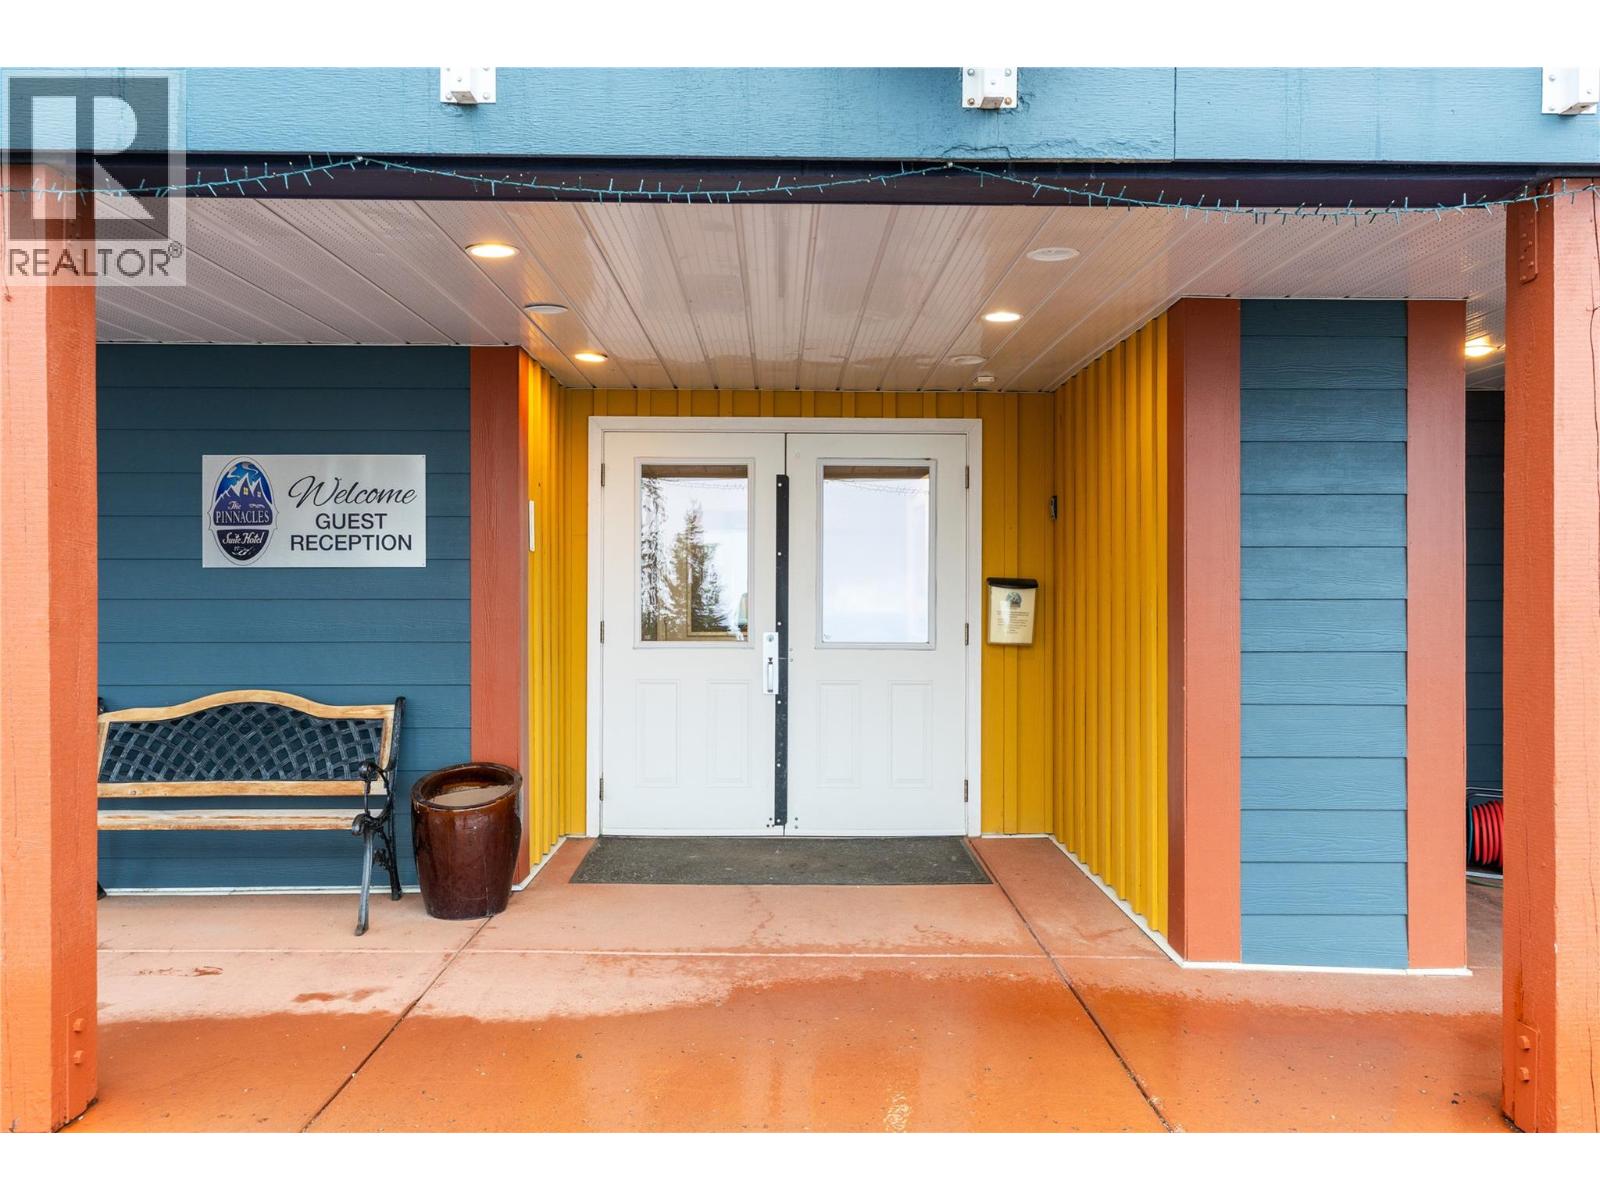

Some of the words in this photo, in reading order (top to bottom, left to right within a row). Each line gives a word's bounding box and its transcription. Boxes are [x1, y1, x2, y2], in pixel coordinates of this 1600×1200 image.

[288, 475, 417, 508] Welcome
[228, 501, 241, 510] The
[215, 510, 270, 524] PINNACLES
[315, 513, 387, 529] GUEST
[222, 532, 241, 544] Suite
[241, 531, 265, 544] Hotel
[290, 534, 412, 551] RECEPTION
